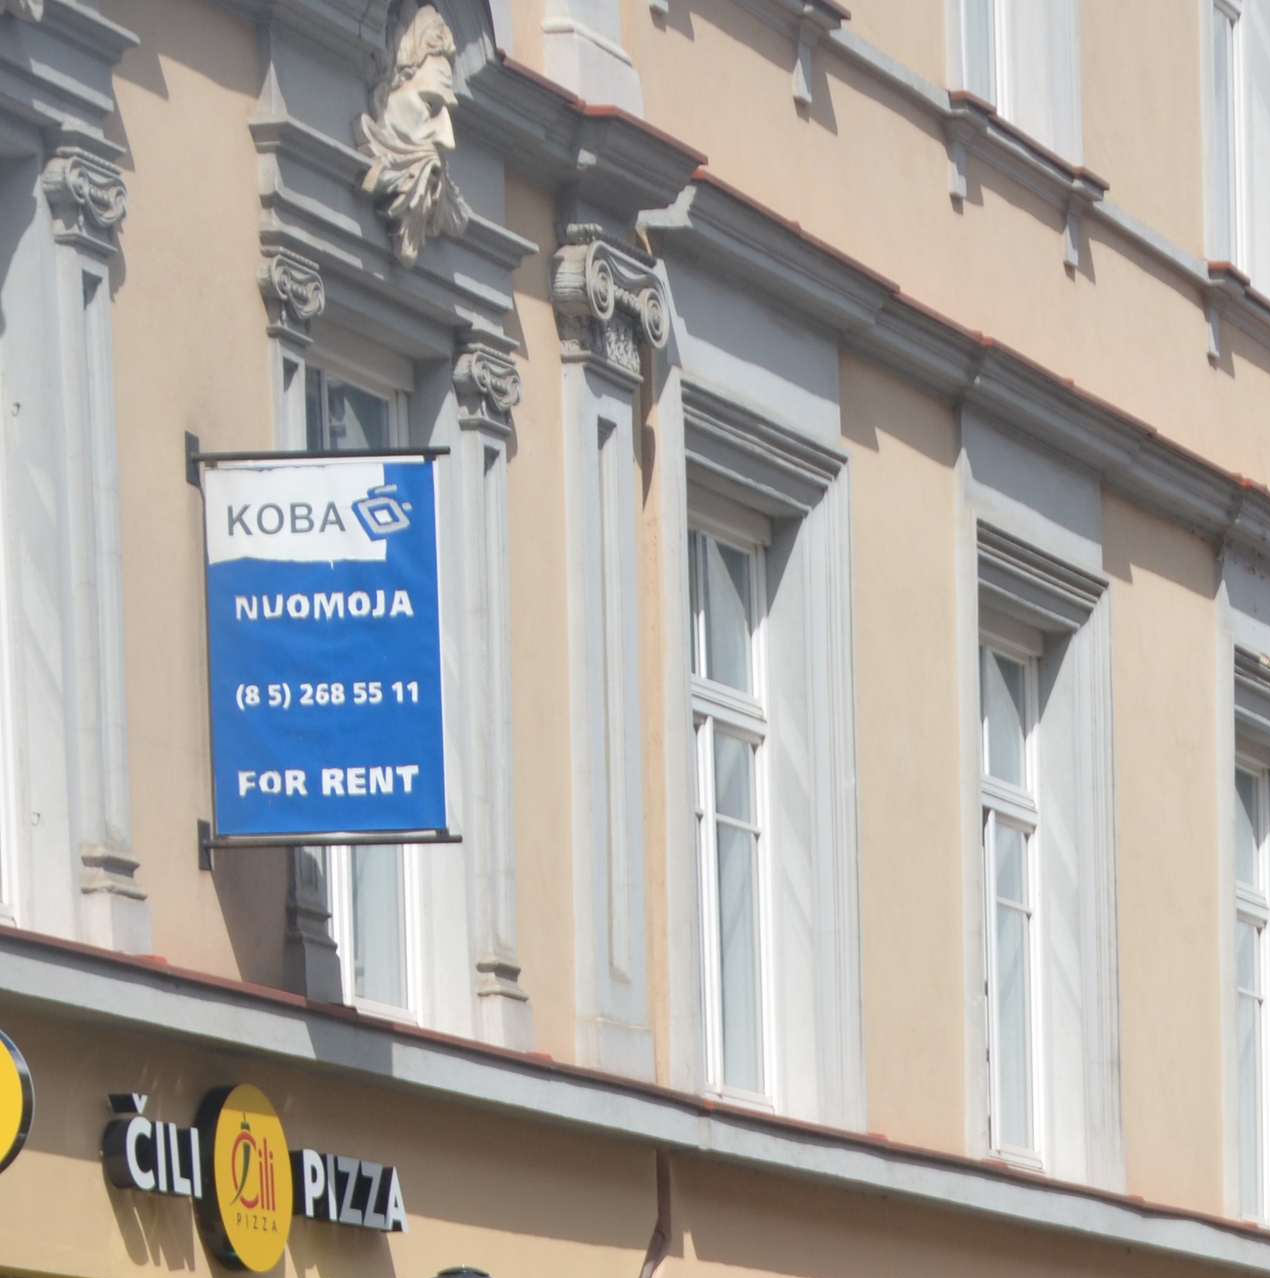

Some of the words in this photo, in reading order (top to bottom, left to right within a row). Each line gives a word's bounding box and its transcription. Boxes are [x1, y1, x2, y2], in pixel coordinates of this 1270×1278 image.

[227, 502, 346, 536] KOBA
[234, 590, 414, 620] NUOMOJA
[235, 683, 260, 710] (8
[268, 682, 291, 708] 5)
[299, 683, 345, 706] 268
[353, 682, 382, 703] 55
[391, 681, 419, 703] 11
[237, 769, 308, 796] FOR
[321, 764, 419, 795] RENT
[126, 1092, 202, 1198] ČILI
[303, 1148, 409, 1233] PIZZA
[236, 1211, 279, 1233] PIZZA
